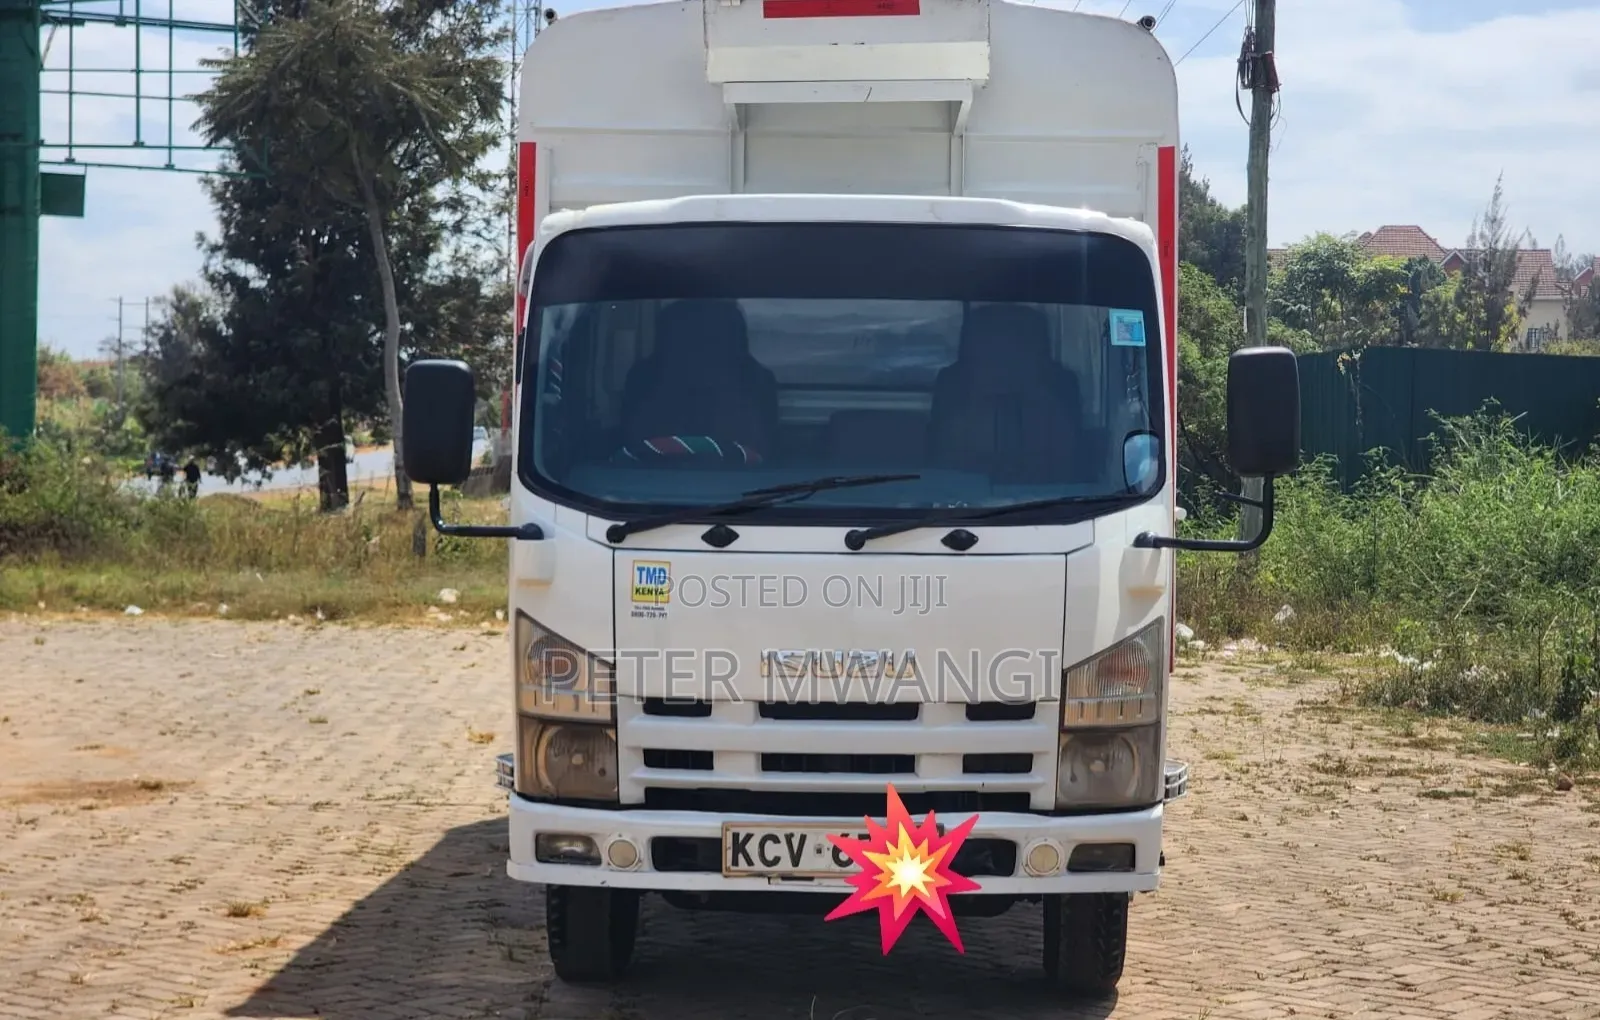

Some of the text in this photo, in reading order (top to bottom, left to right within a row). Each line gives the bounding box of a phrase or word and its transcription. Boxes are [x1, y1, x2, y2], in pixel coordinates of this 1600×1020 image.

[636, 565, 668, 586] TMD
[635, 586, 666, 597] KENYA
[760, 649, 916, 679] ISUZU
[731, 832, 807, 868] KCV
